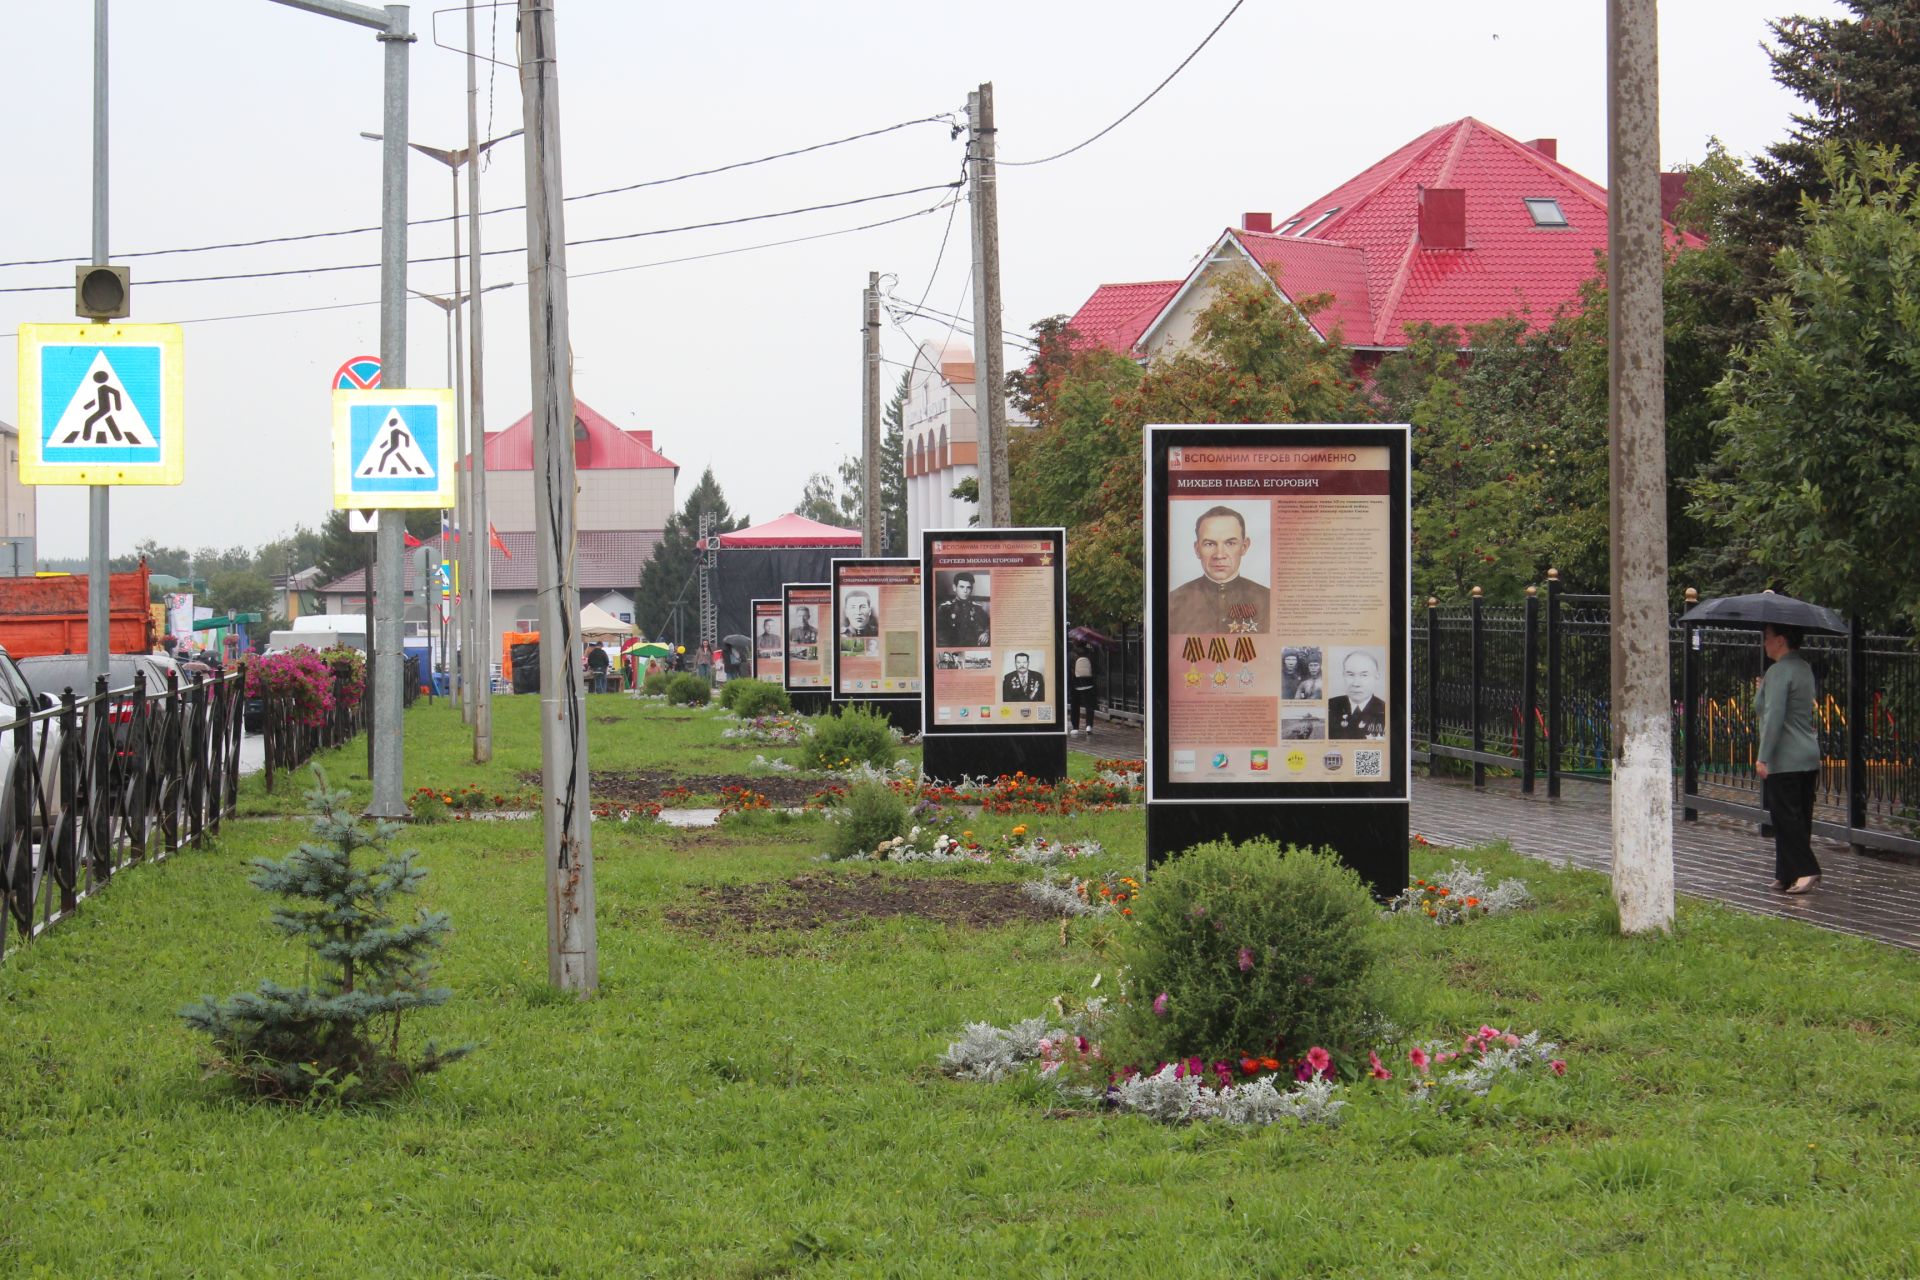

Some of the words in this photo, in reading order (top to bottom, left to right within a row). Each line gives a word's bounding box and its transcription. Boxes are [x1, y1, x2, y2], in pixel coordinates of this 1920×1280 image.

[1184, 453, 1250, 463] ВСПОМНИМ
[1253, 453, 1290, 463] ГЕРОЕВ
[1294, 453, 1357, 463] ПОИМЕННО
[1177, 479, 1223, 488] МИХЕЕВ
[1225, 479, 1260, 488] ПАВЕЛ
[1263, 478, 1319, 487] ЕГОРОВИЧ
